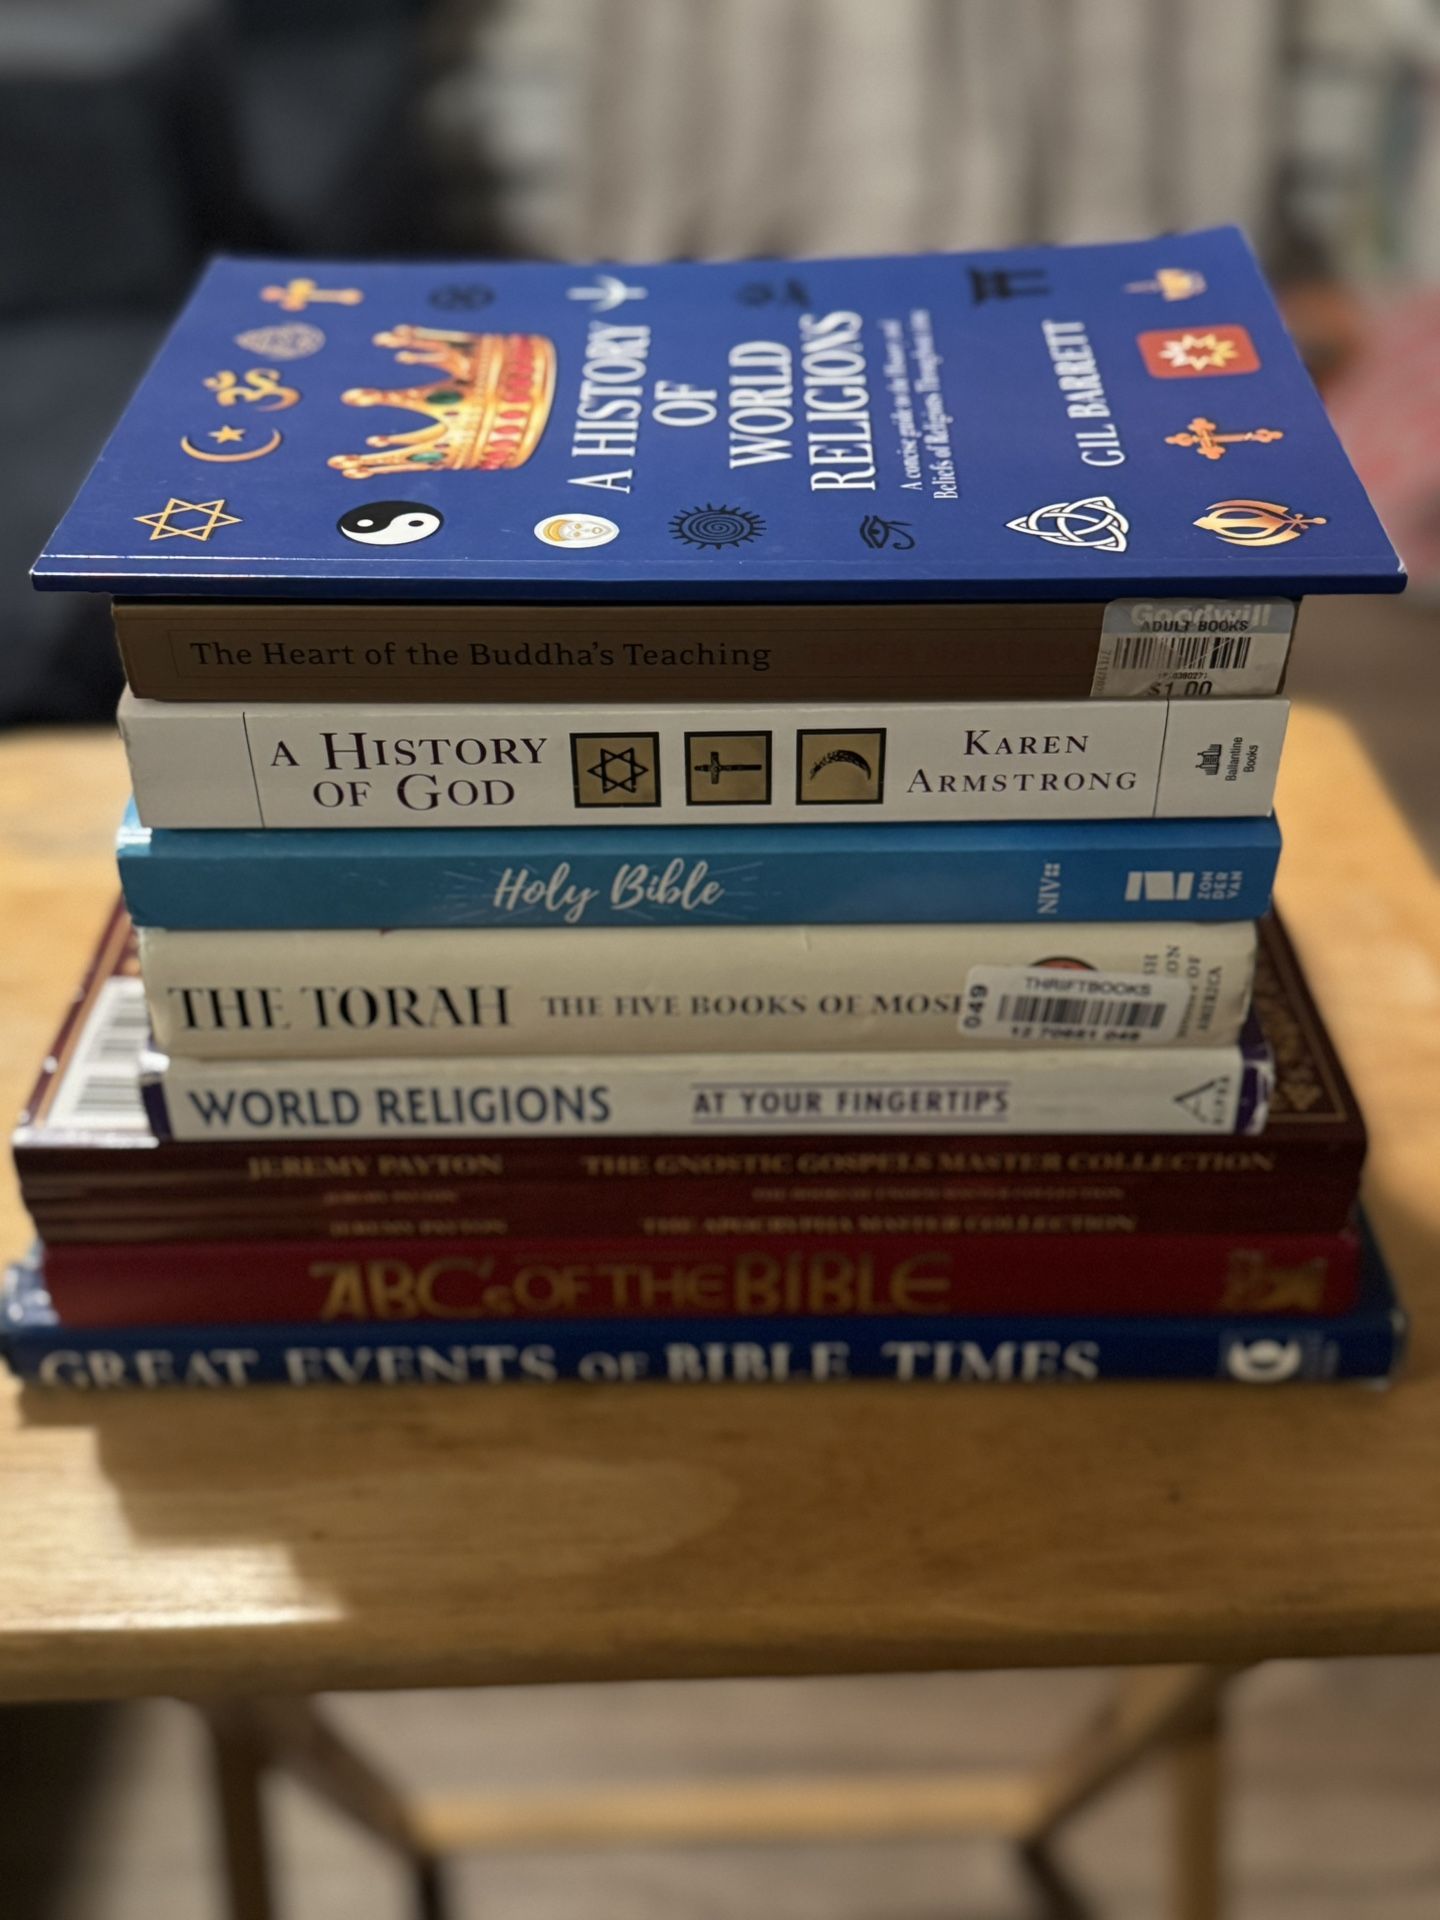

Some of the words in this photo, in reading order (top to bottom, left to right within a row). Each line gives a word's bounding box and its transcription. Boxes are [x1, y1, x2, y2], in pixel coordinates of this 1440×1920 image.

[1041, 319, 1112, 419] BARRETT
[571, 319, 652, 458] HISTORY
[651, 379, 718, 427] OF
[728, 340, 795, 469] WORLD
[799, 310, 877, 492] RELIGIONS
[896, 438, 922, 479] concise
[925, 445, 952, 459] of
[1074, 422, 1126, 467] GIL
[567, 467, 634, 494] A
[900, 481, 923, 491] A
[929, 459, 959, 499] Beliefs
[1130, 603, 1272, 627] Goodwill
[1141, 620, 1191, 633] ADULT
[1197, 619, 1249, 632] BOOKS
[190, 641, 253, 667] The
[261, 640, 356, 667] Heart
[364, 640, 397, 666] of
[406, 641, 460, 667] the
[470, 640, 615, 668] Buddha's
[622, 641, 772, 671] Teaching
[1147, 680, 1213, 697] $100
[270, 740, 301, 768] A
[319, 731, 548, 771] HISTORY
[963, 728, 1090, 756] KAREN
[1224, 736, 1243, 781] Ballantine
[1243, 744, 1259, 773] Books
[312, 779, 372, 808] OF
[396, 772, 516, 811] GOD
[906, 768, 1138, 793] ARMSTRONG
[493, 861, 600, 925] Holy
[610, 857, 726, 911] Bible
[1037, 878, 1061, 914] NIV
[1197, 871, 1214, 900] ZON
[1212, 871, 1229, 900] DER
[1226, 870, 1243, 899] VAN
[1024, 975, 1153, 998] THRIFTBOOKS
[167, 986, 292, 1030] THE
[300, 985, 514, 1030] TORAH
[541, 995, 605, 1017] THE
[615, 995, 682, 1016] FIVE
[691, 994, 807, 1016] BOOKS
[819, 994, 865, 1016] OF
[870, 993, 962, 1016] MOS
[963, 983, 989, 1029] 049
[187, 1088, 360, 1127] WORLD
[376, 1085, 612, 1125] RELIGIONS
[693, 1090, 727, 1115] AT
[740, 1089, 821, 1115] YOUR
[836, 1088, 1010, 1115] FINGERTIPS
[248, 1155, 371, 1181] JEREMY
[377, 1153, 504, 1176] PAYTON
[582, 1154, 651, 1176] THE
[654, 1153, 794, 1176] GNOSTIC
[797, 1152, 934, 1174] GOSPELS
[938, 1151, 1063, 1173] MASTER
[1067, 1151, 1275, 1173] COLLECTION
[512, 1263, 592, 1314] OF
[597, 1263, 728, 1314] THE
[733, 1249, 955, 1318] BIBLE
[38, 1347, 260, 1389] GREAT
[284, 1343, 559, 1386] EVENTS
[577, 1350, 650, 1384] OF
[664, 1341, 852, 1383] BIBLE
[880, 1340, 1101, 1382] TIMES
